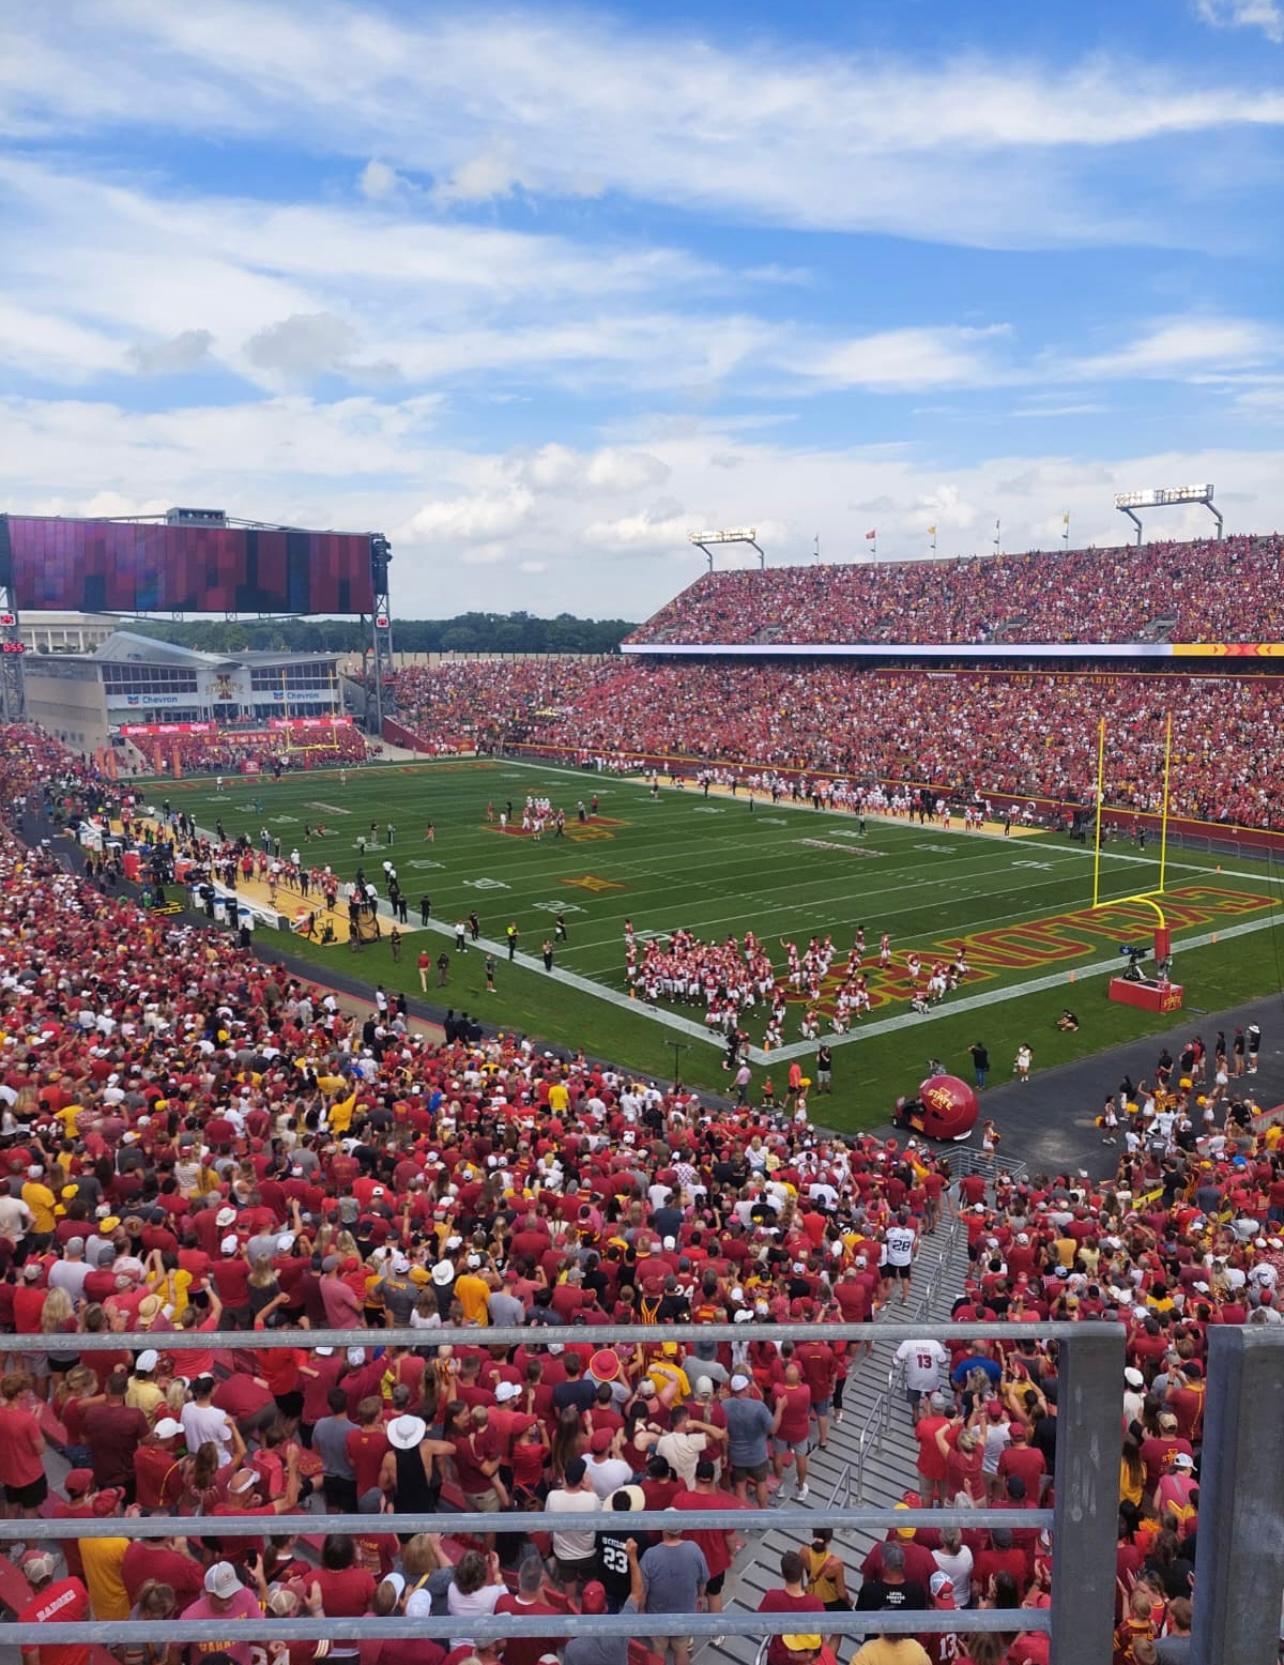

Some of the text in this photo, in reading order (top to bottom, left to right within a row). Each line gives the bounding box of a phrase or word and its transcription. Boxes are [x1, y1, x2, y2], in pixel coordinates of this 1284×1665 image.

[142, 695, 178, 703] Chevron
[287, 691, 320, 699] Chevron
[768, 886, 1283, 1019] CYCLONES
[928, 1088, 953, 1111] STATE
[892, 1239, 911, 1252] 28
[917, 1354, 932, 1369] 13
[603, 1546, 628, 1574] 23
